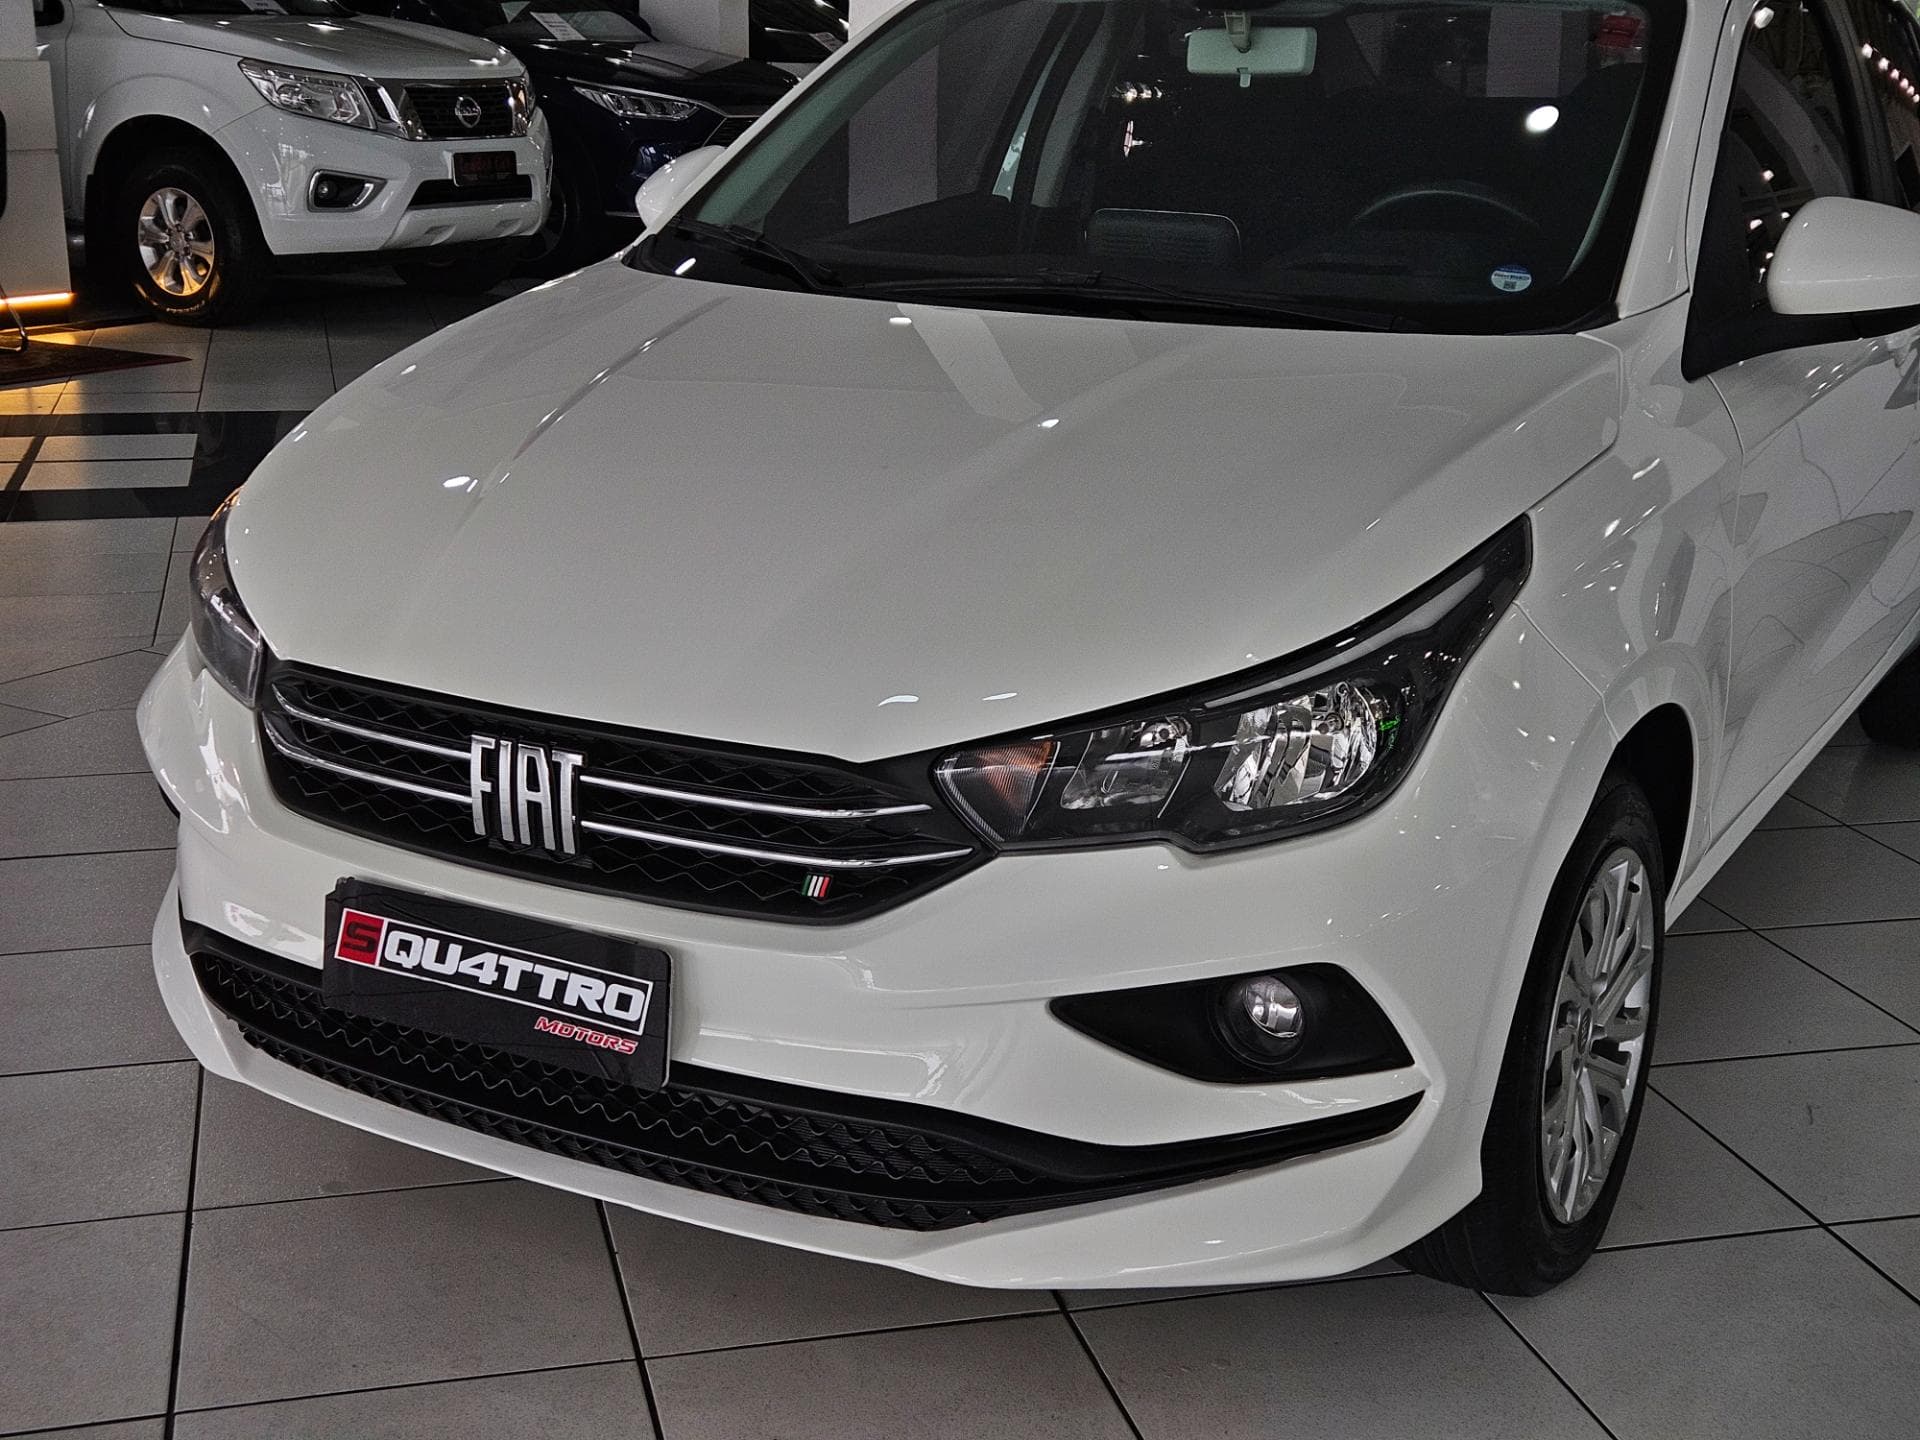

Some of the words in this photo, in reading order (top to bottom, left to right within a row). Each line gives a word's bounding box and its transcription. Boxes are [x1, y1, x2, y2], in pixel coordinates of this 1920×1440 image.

[470, 733, 584, 856] FIAT
[342, 920, 646, 1022] SQU4TTRO
[534, 1016, 639, 1055] MOTORS
